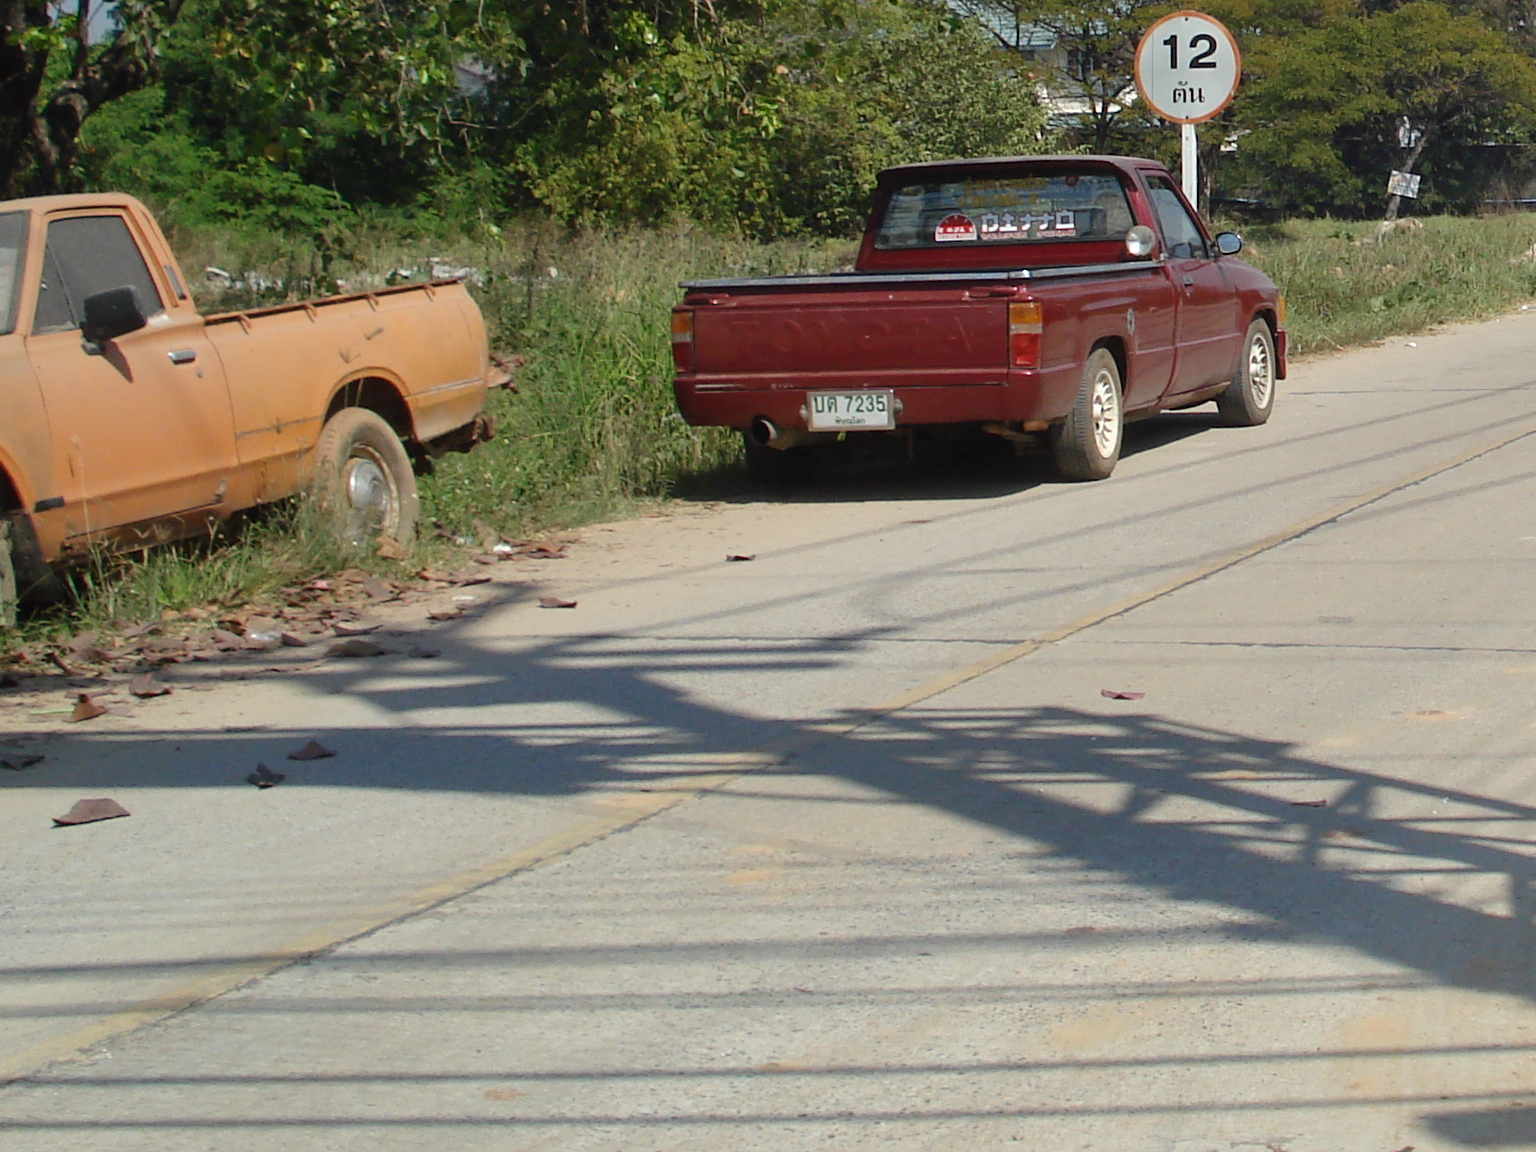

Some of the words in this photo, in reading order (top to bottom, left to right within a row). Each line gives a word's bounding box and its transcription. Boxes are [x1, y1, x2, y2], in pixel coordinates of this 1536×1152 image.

[1162, 33, 1218, 70] 12
[1172, 80, 1206, 104] ตัน
[844, 394, 887, 414] 7235
